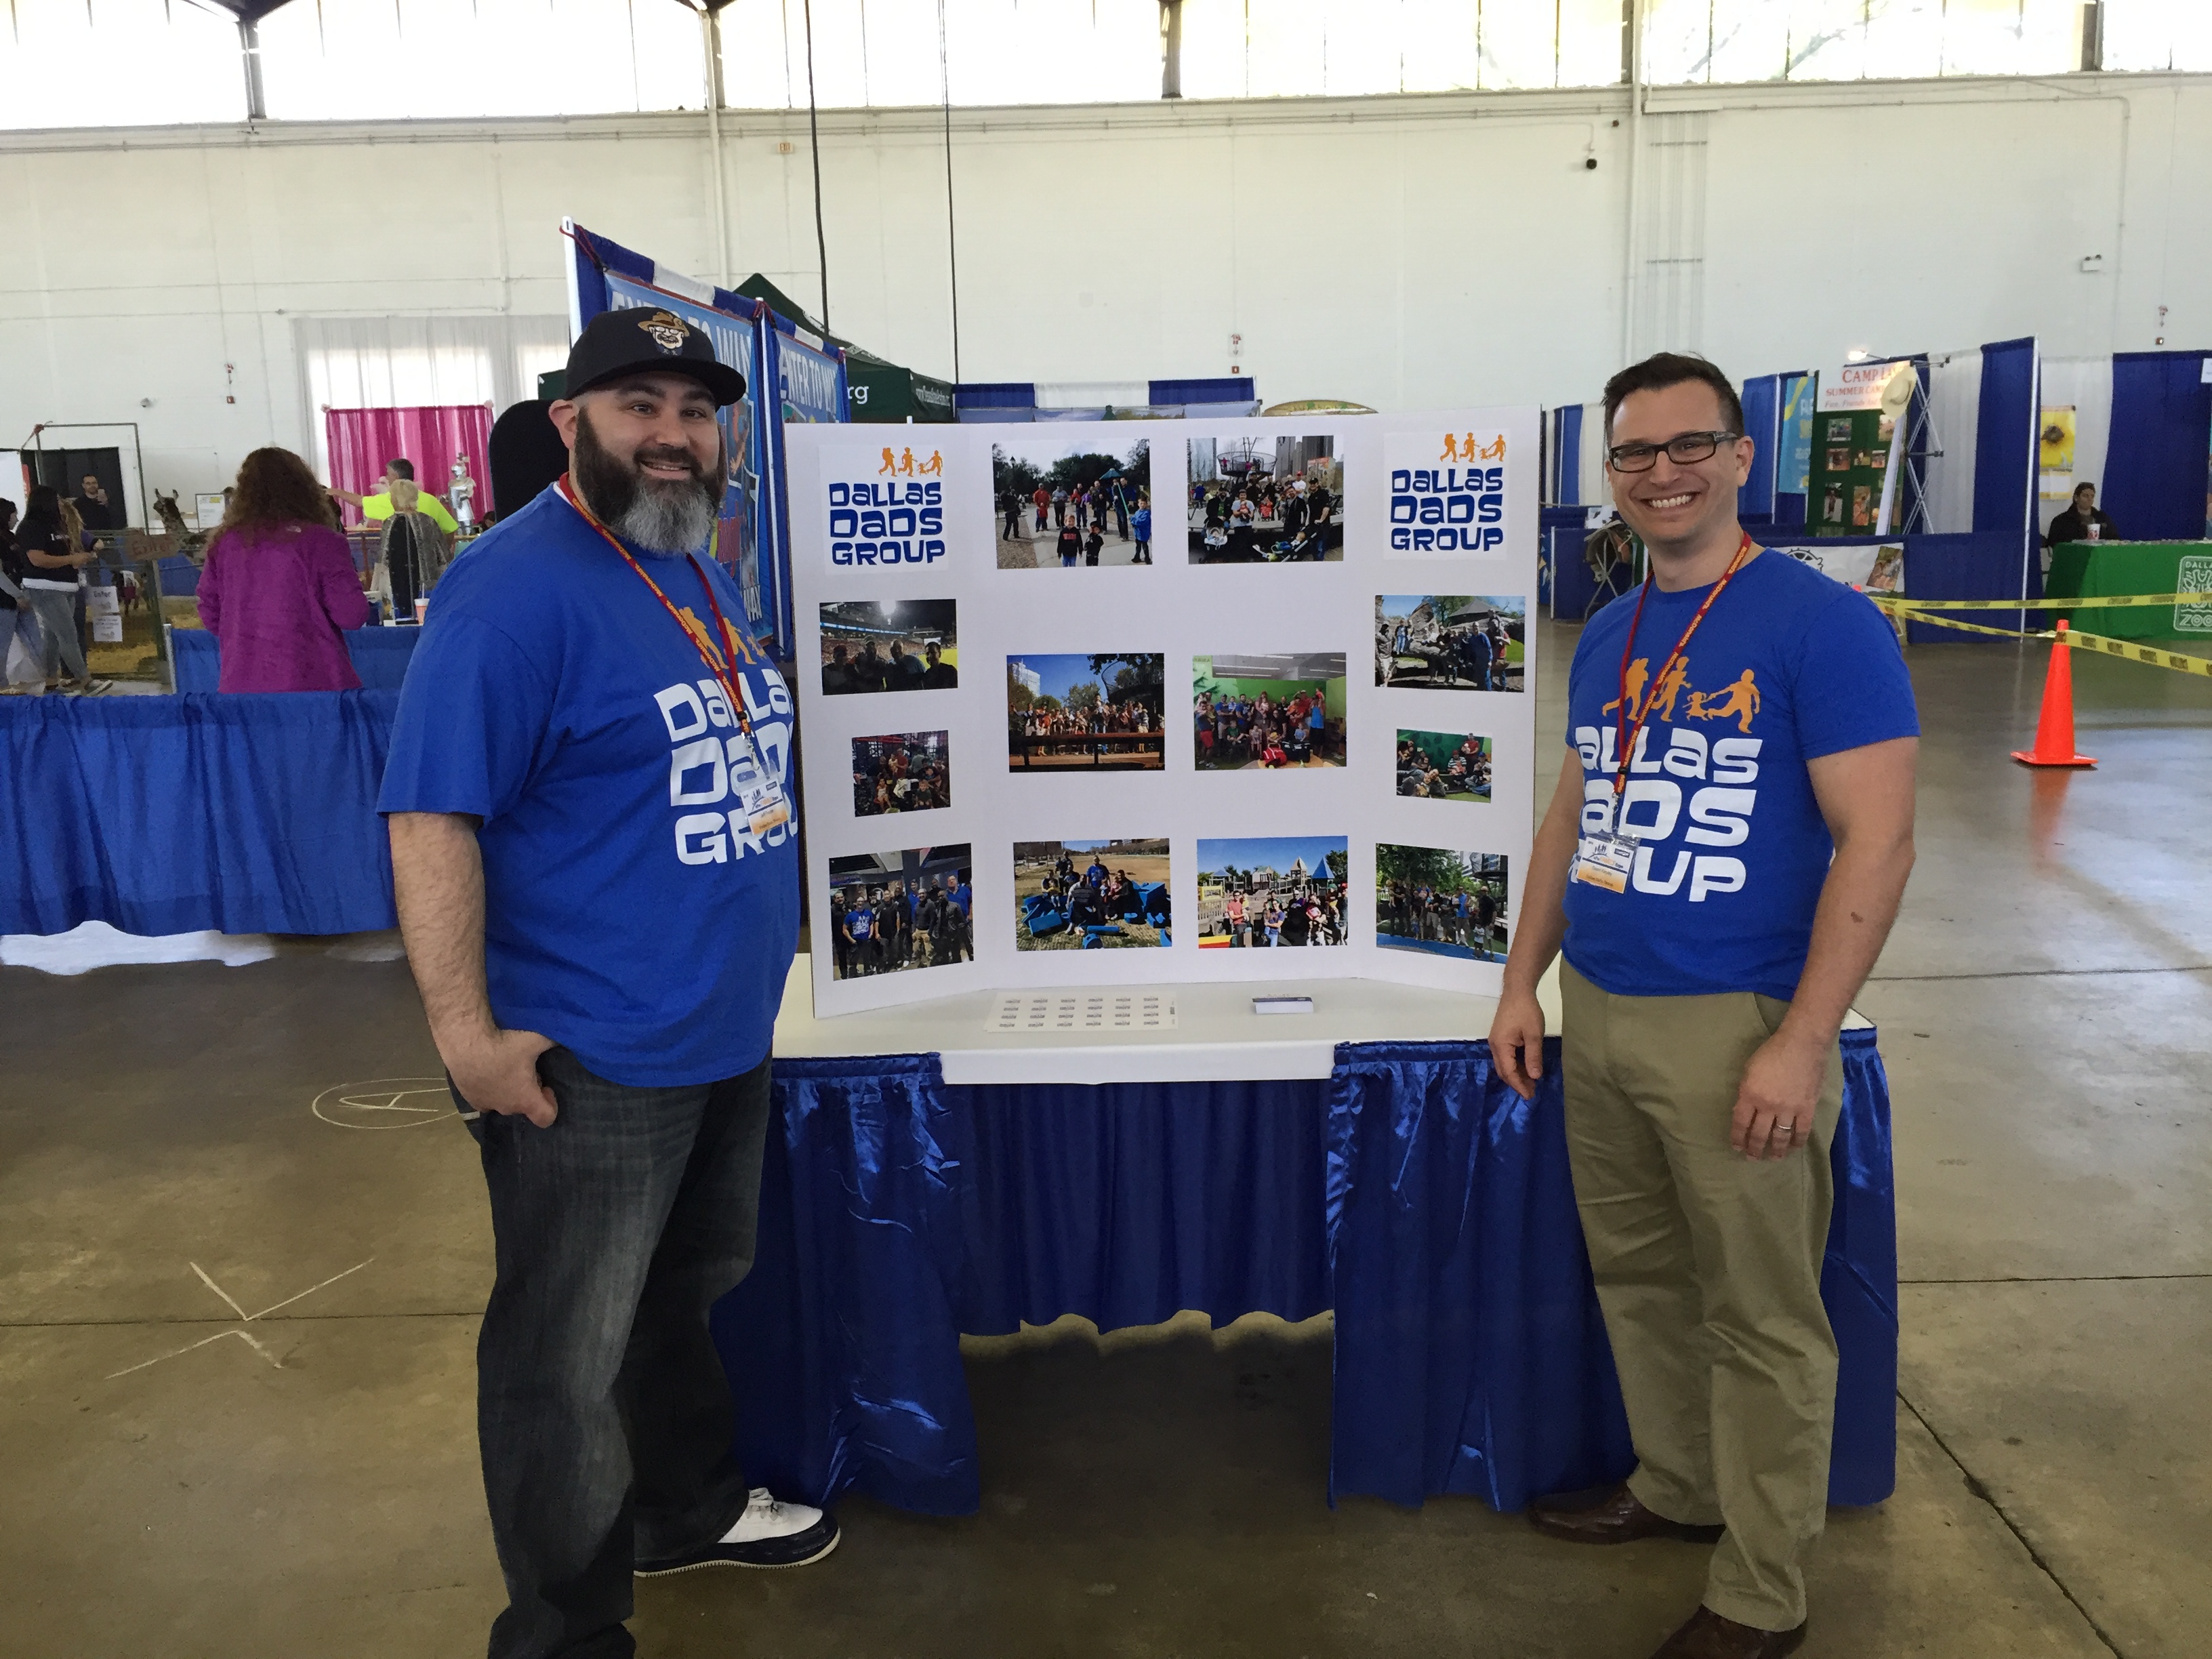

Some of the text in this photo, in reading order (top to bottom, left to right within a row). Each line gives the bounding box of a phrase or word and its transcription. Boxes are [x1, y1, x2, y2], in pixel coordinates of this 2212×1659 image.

[1842, 369, 1879, 384] CAMP
[1826, 386, 1864, 396] SUMMER
[1391, 527, 1503, 552] GROUP
[832, 540, 945, 565] GROUP
[2175, 614, 2212, 627] ZOO
